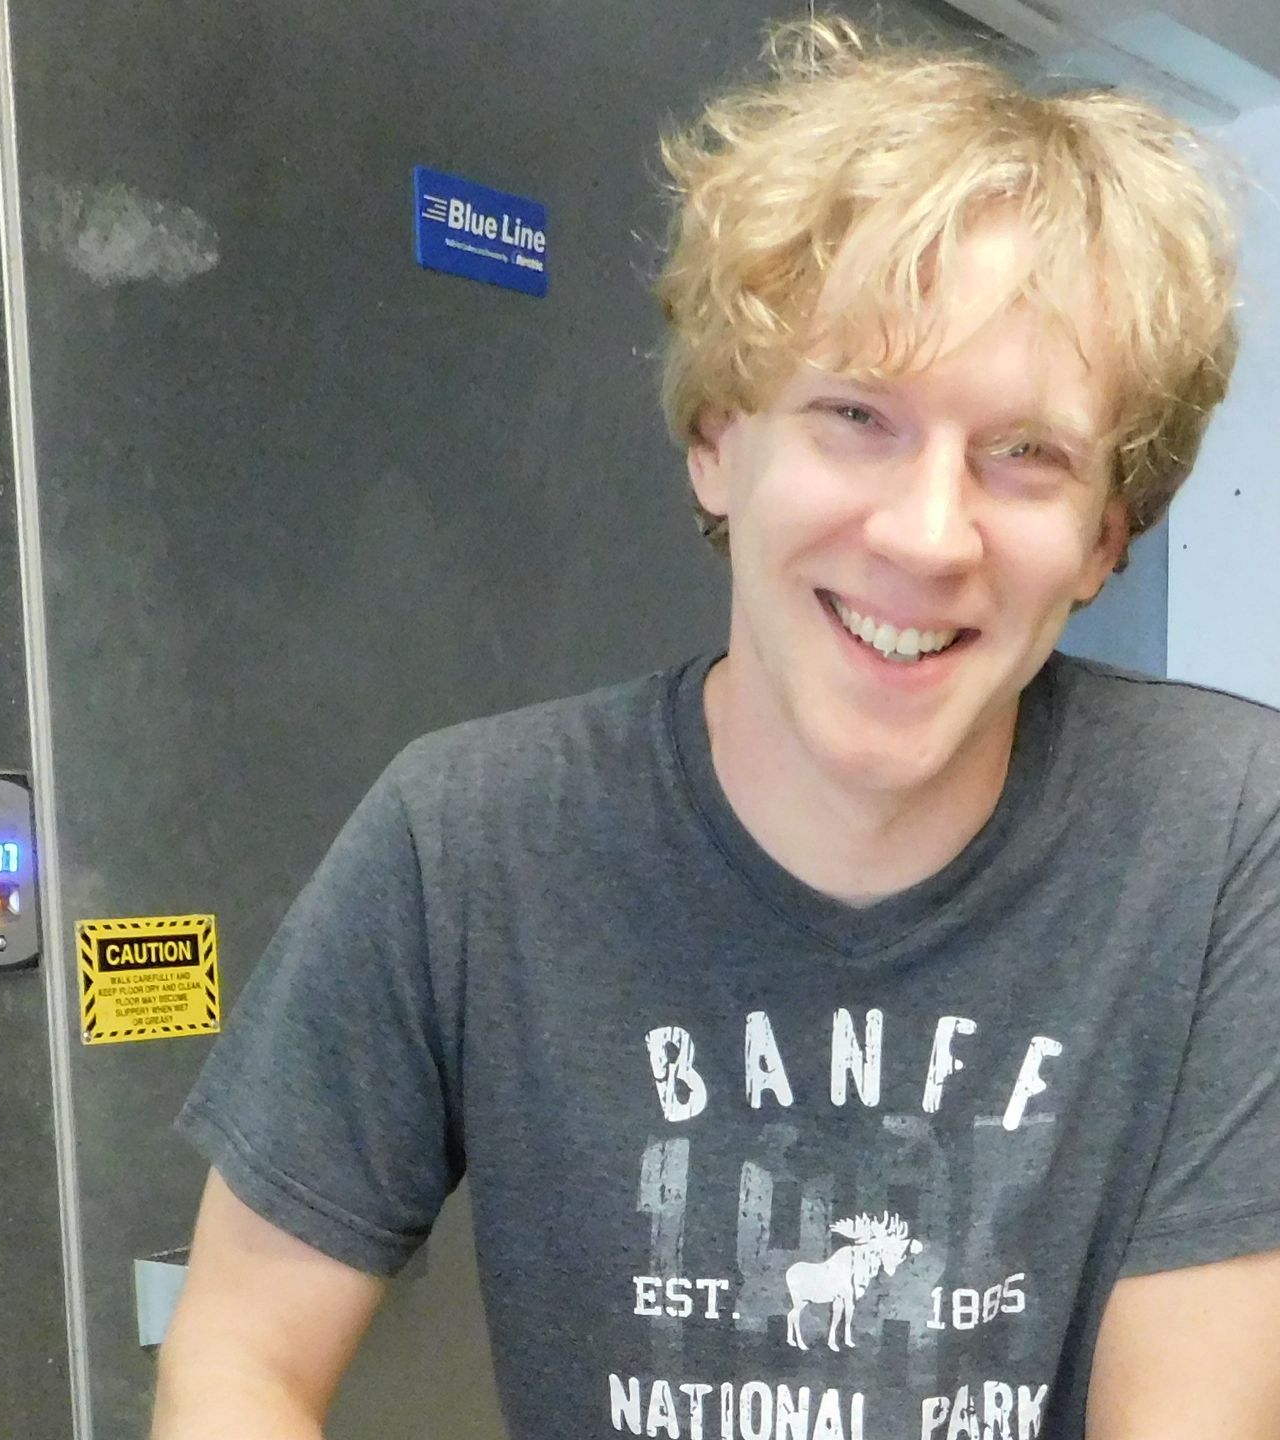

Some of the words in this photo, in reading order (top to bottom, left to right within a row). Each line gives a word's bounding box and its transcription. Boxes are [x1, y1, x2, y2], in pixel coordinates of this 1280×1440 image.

[447, 198, 498, 240] Blue
[501, 213, 546, 254] Line
[106, 941, 192, 965] CAUTION
[645, 1008, 1063, 1131] BANFF
[632, 1275, 741, 1320] EST.
